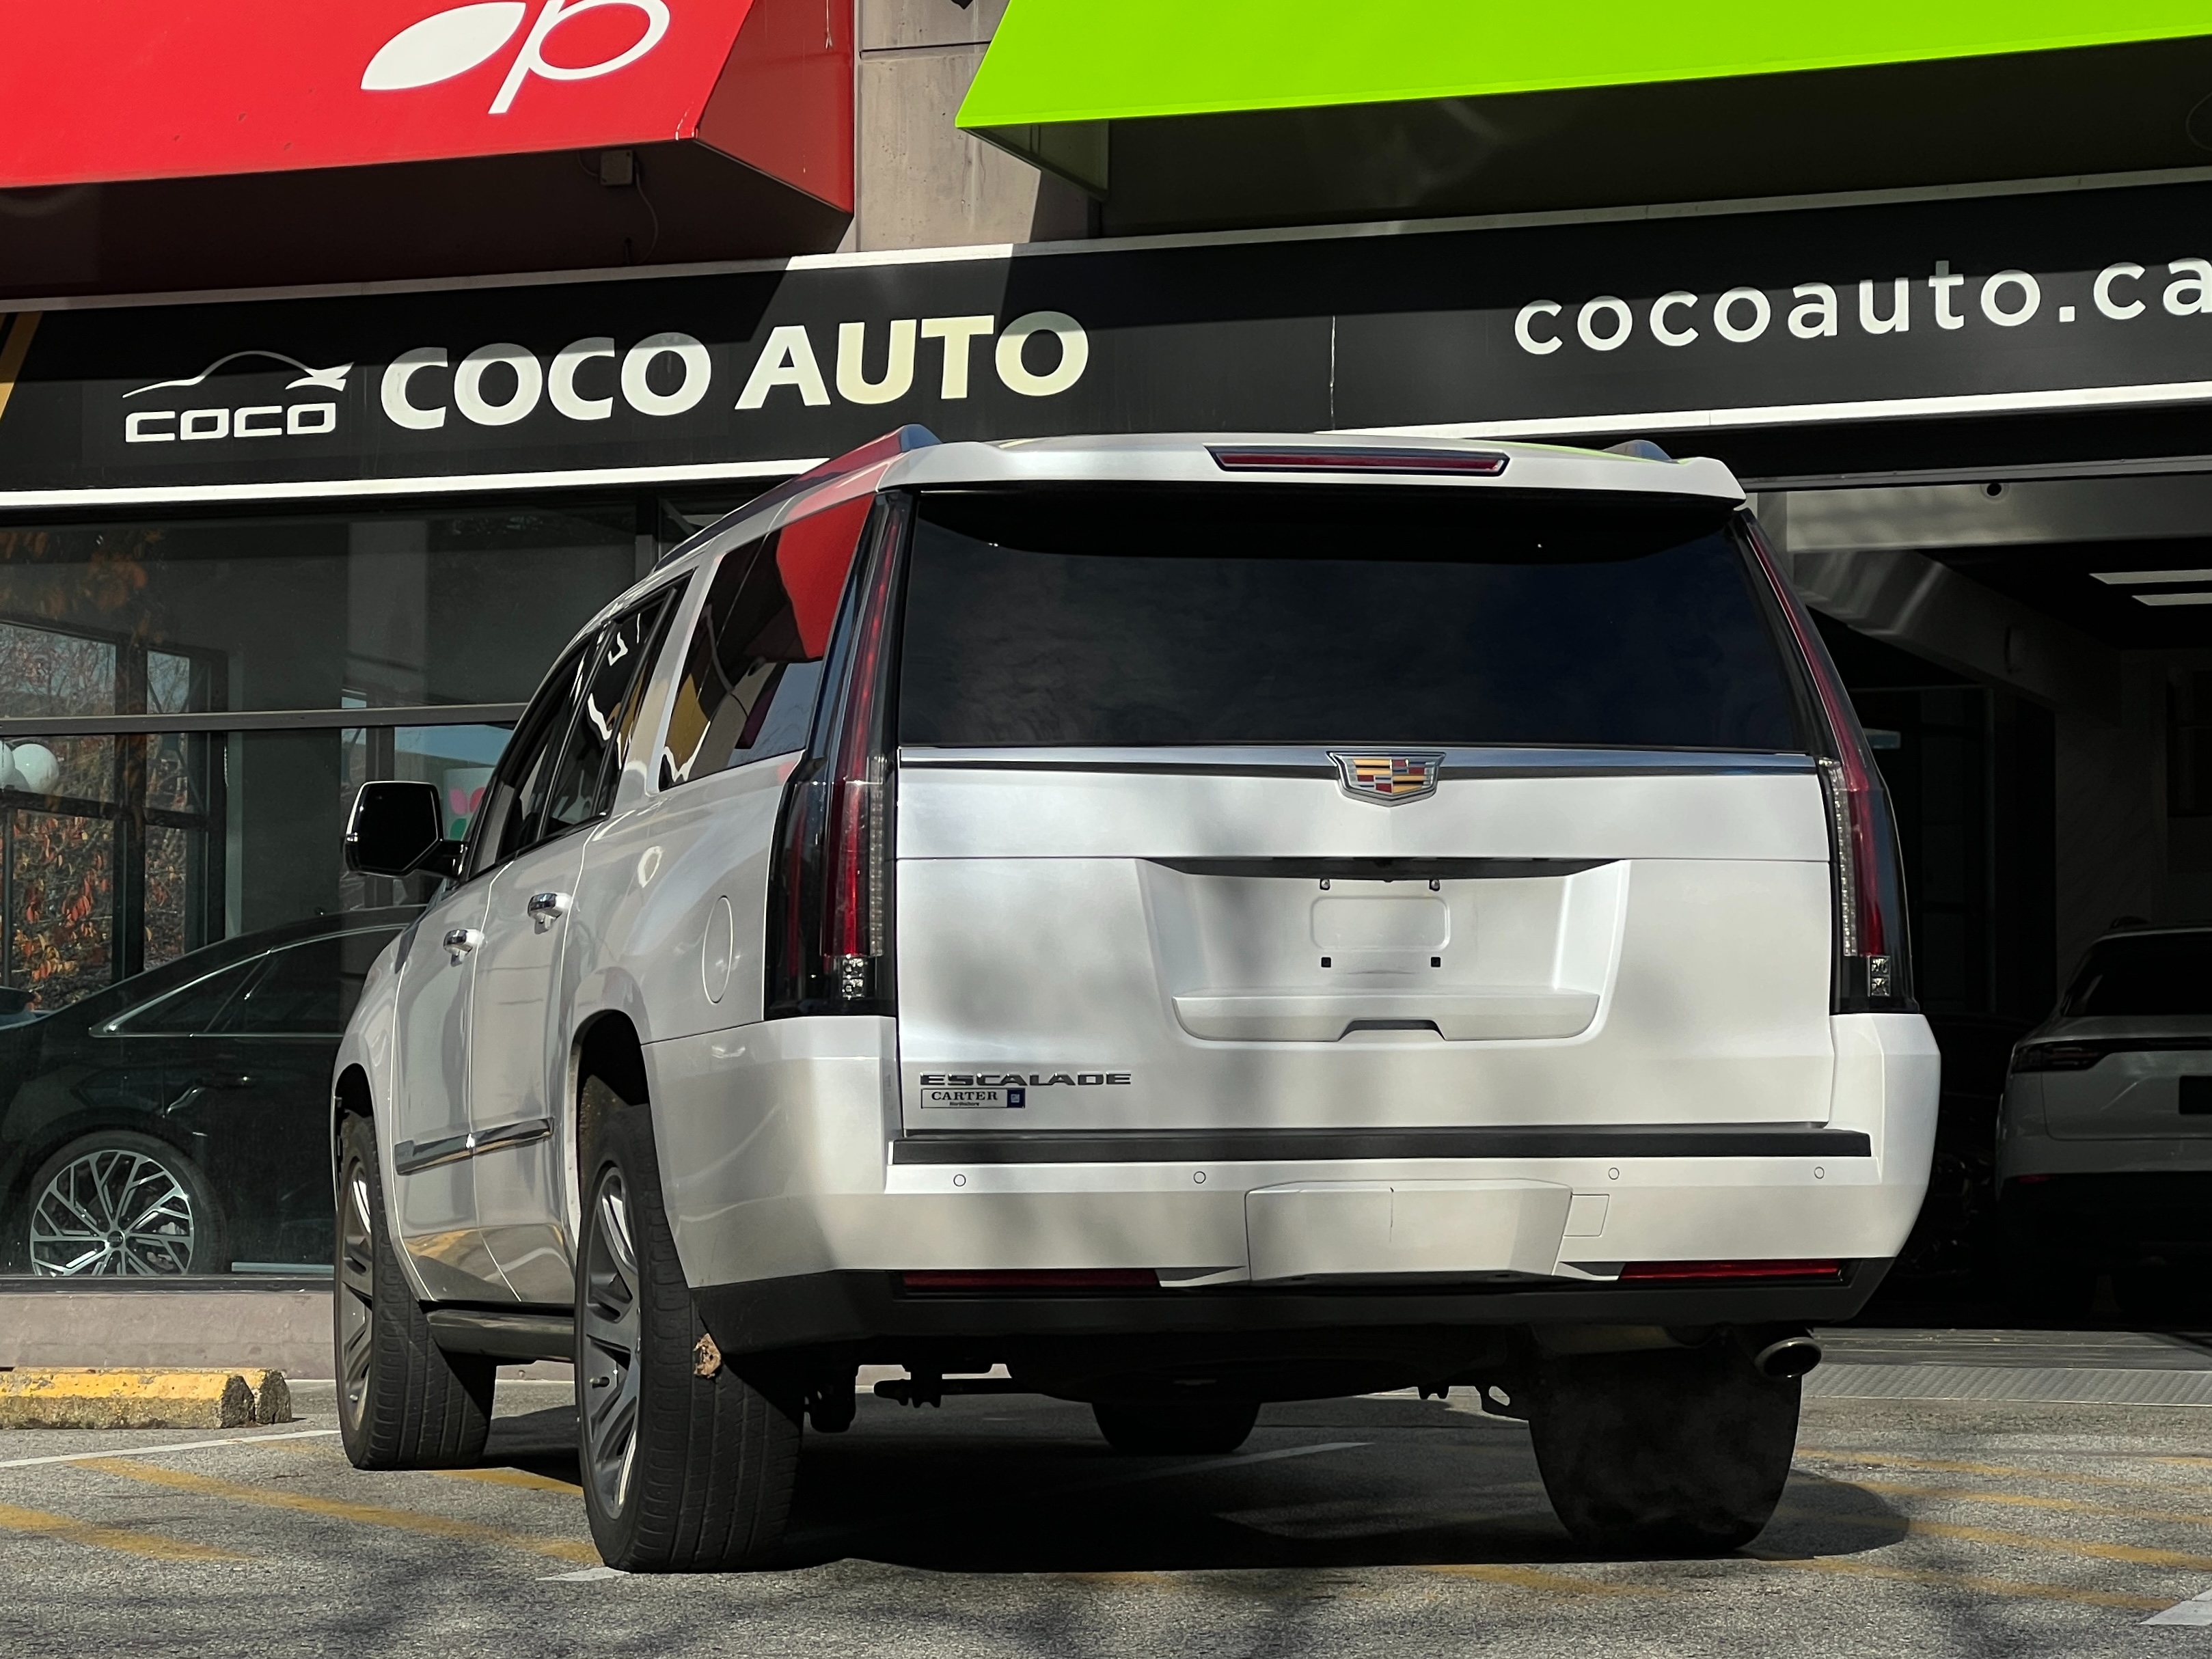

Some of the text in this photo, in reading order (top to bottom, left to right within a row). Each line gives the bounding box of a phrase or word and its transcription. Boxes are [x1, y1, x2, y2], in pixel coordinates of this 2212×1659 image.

[1514, 258, 2212, 355] cocoauto.ca
[380, 311, 1089, 430] COCO AUTO
[125, 402, 337, 443] COCO
[919, 1071, 1132, 1086] ESCALADE
[931, 1091, 998, 1101] CARTER
